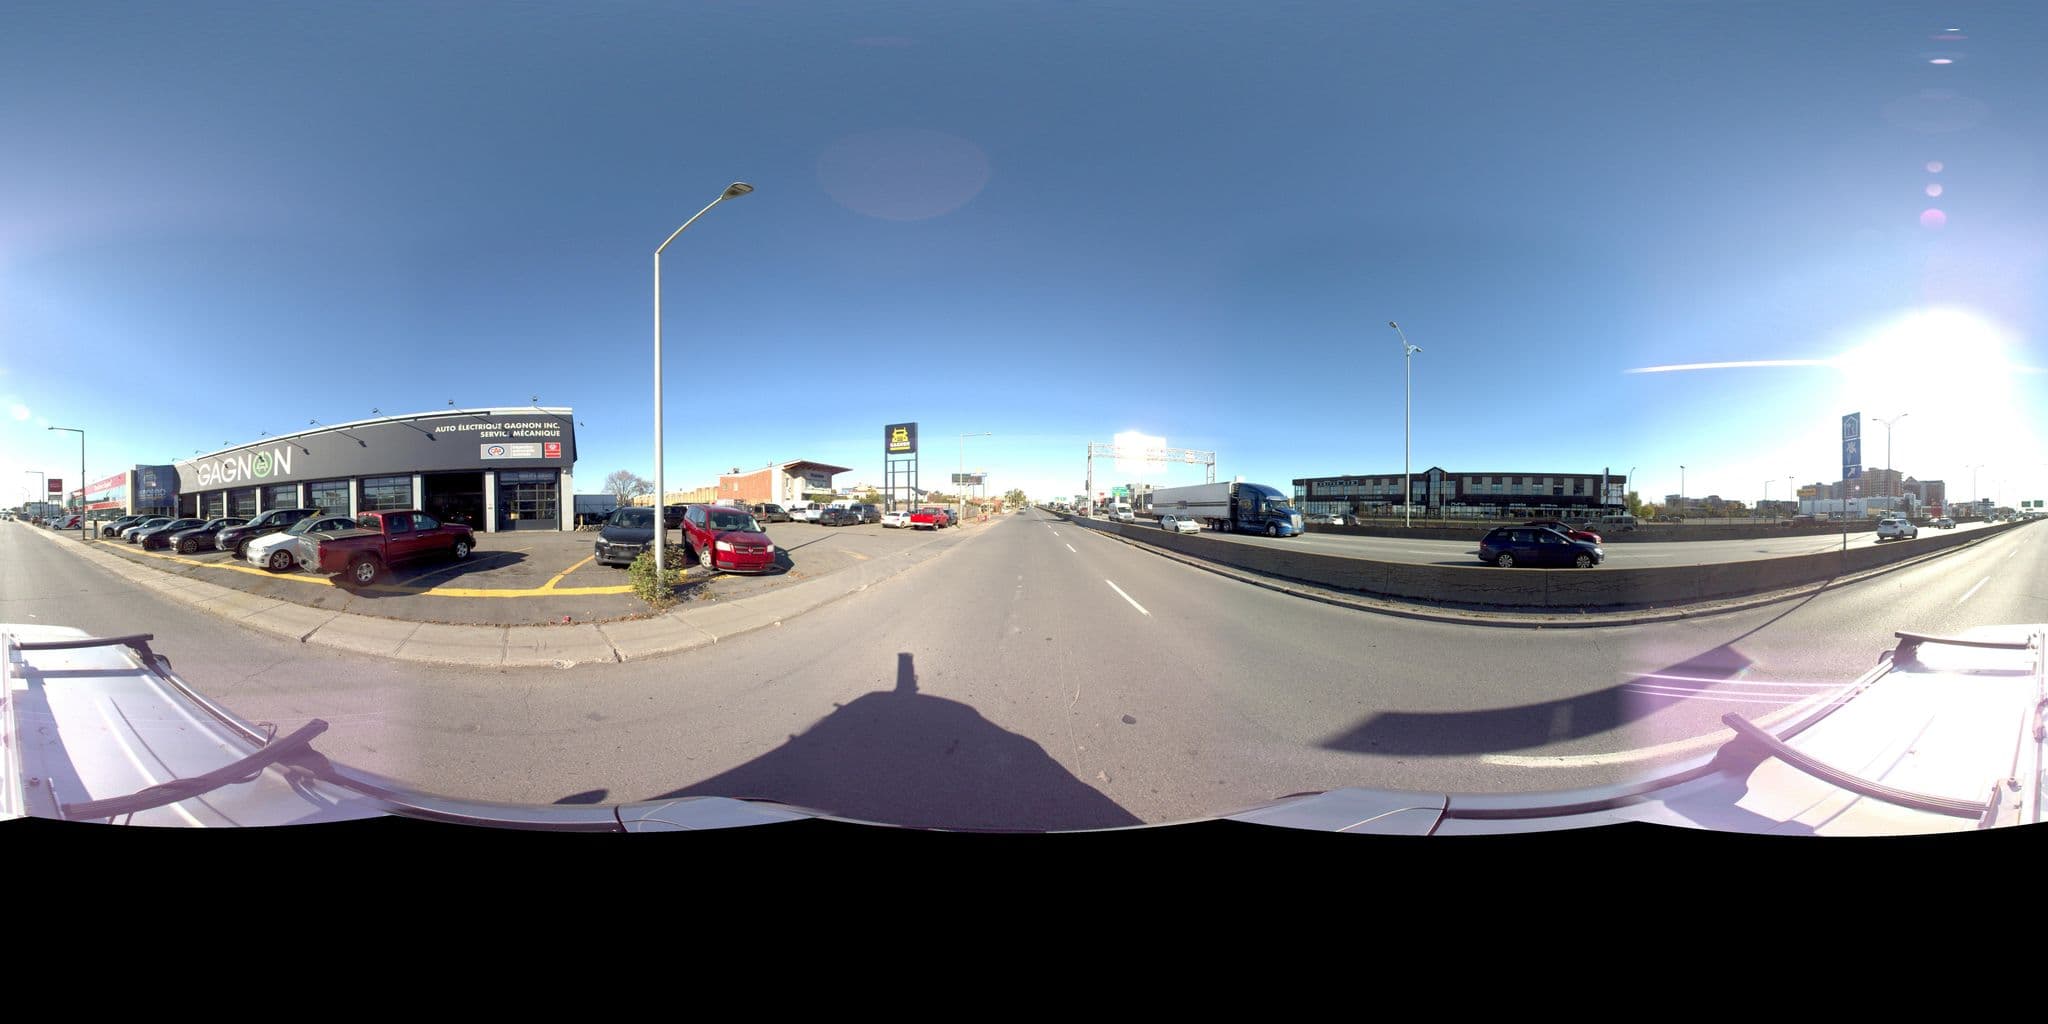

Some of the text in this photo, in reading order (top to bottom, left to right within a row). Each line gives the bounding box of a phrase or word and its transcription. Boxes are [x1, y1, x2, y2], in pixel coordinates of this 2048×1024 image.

[435, 425, 456, 433] AUTO
[458, 423, 502, 432] ÉLECTRIQUE
[504, 422, 542, 430] GAGNON
[480, 430, 509, 438] SERVIC
[198, 446, 291, 486] GAGNON
